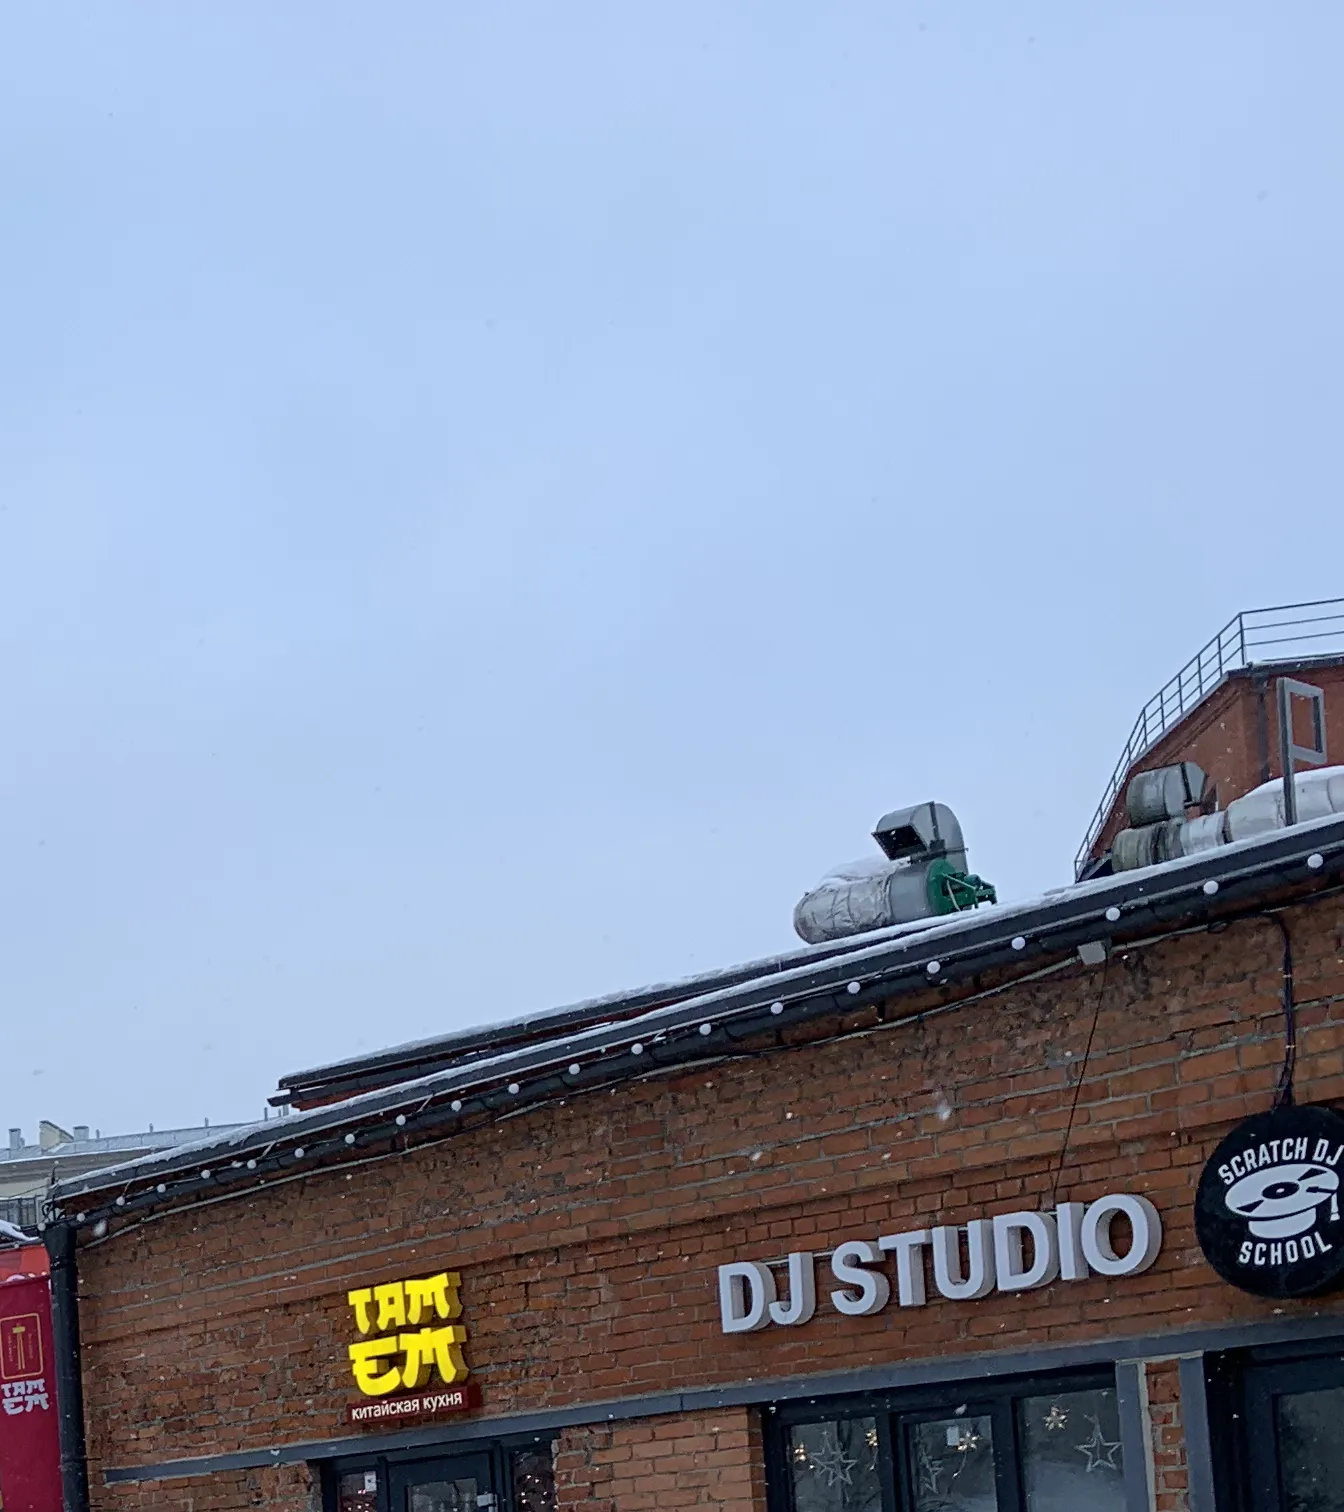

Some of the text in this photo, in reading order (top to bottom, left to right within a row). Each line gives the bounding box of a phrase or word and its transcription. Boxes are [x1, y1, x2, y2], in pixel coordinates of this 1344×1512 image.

[1218, 1137, 1344, 1185] SCRATCH DJ
[718, 1193, 1162, 1334] DJ STUDIO
[1238, 1231, 1333, 1266] SCHOOL
[348, 1272, 454, 1335] ТАМ
[348, 1325, 458, 1396] ЕМ
[351, 1392, 463, 1421] китайская кухня
